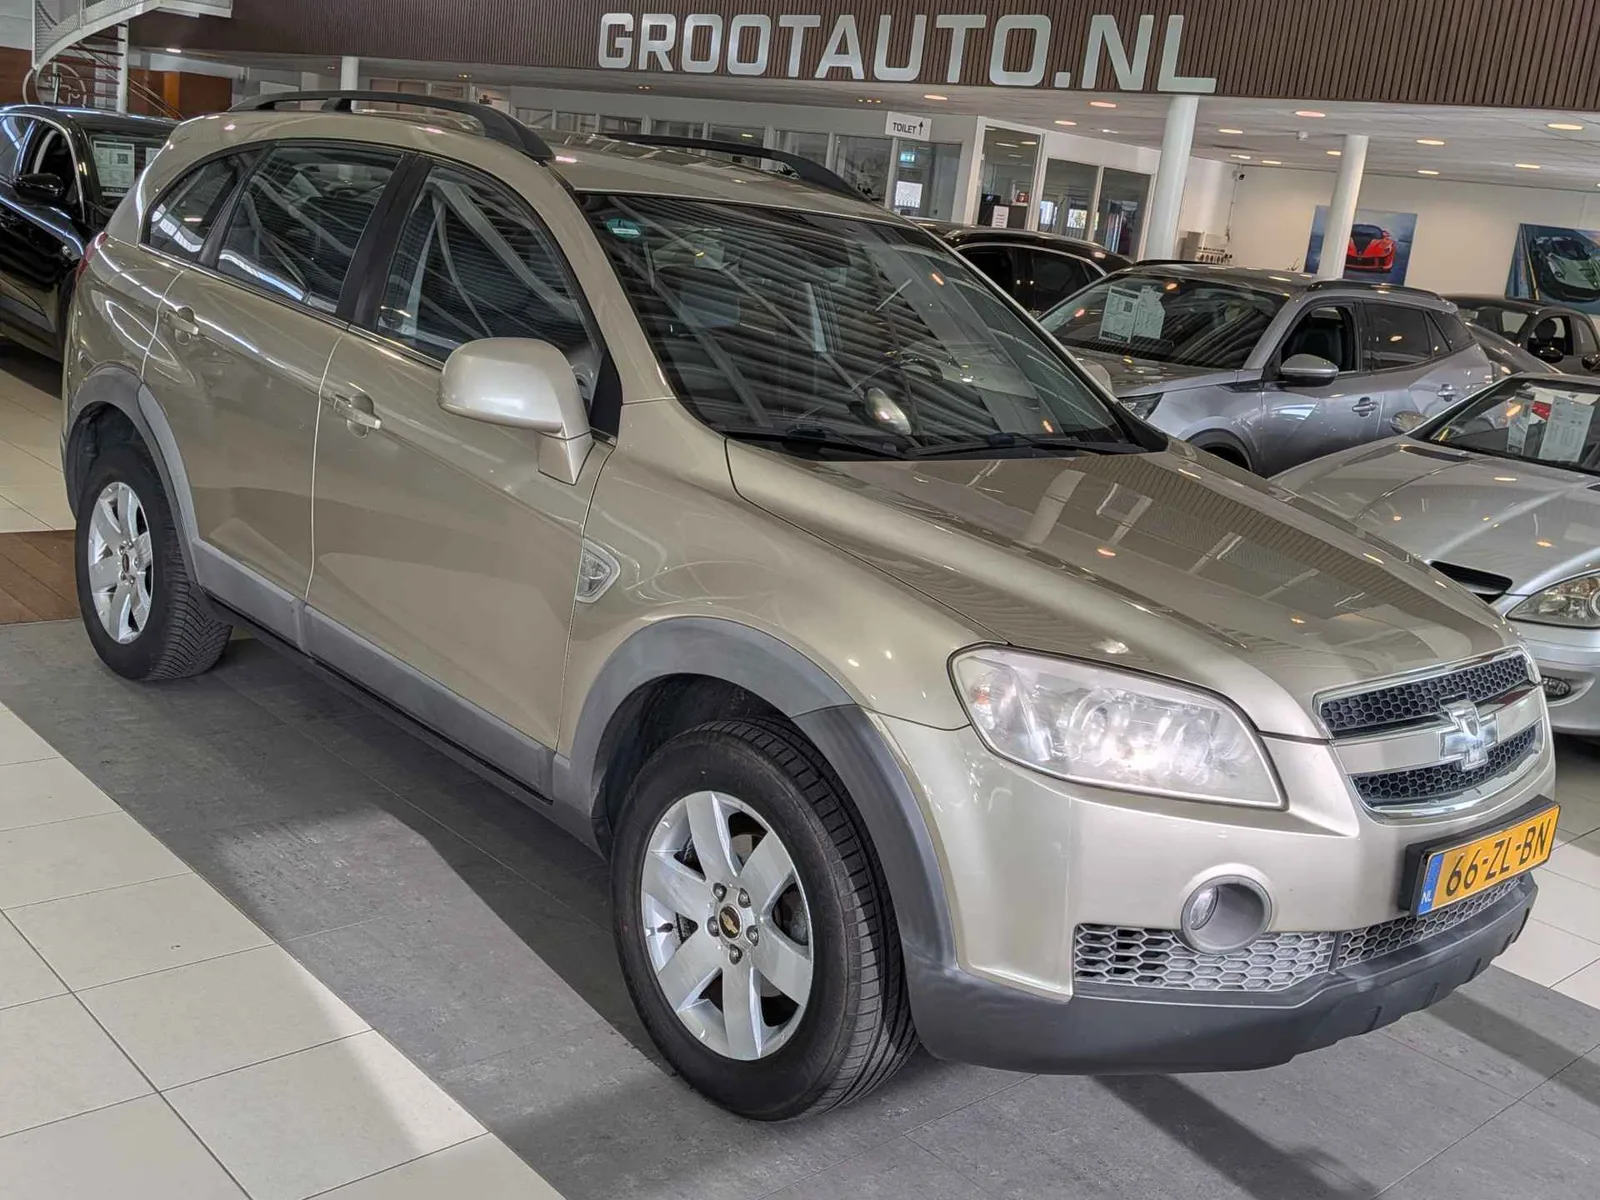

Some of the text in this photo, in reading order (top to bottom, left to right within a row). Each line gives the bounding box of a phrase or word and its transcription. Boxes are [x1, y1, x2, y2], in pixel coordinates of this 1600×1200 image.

[598, 12, 1217, 93] GROOTAUTO.NL
[893, 121, 917, 135] TOILET
[1446, 818, 1552, 897] 66-ZL-BN
[1421, 890, 1432, 905] NL
